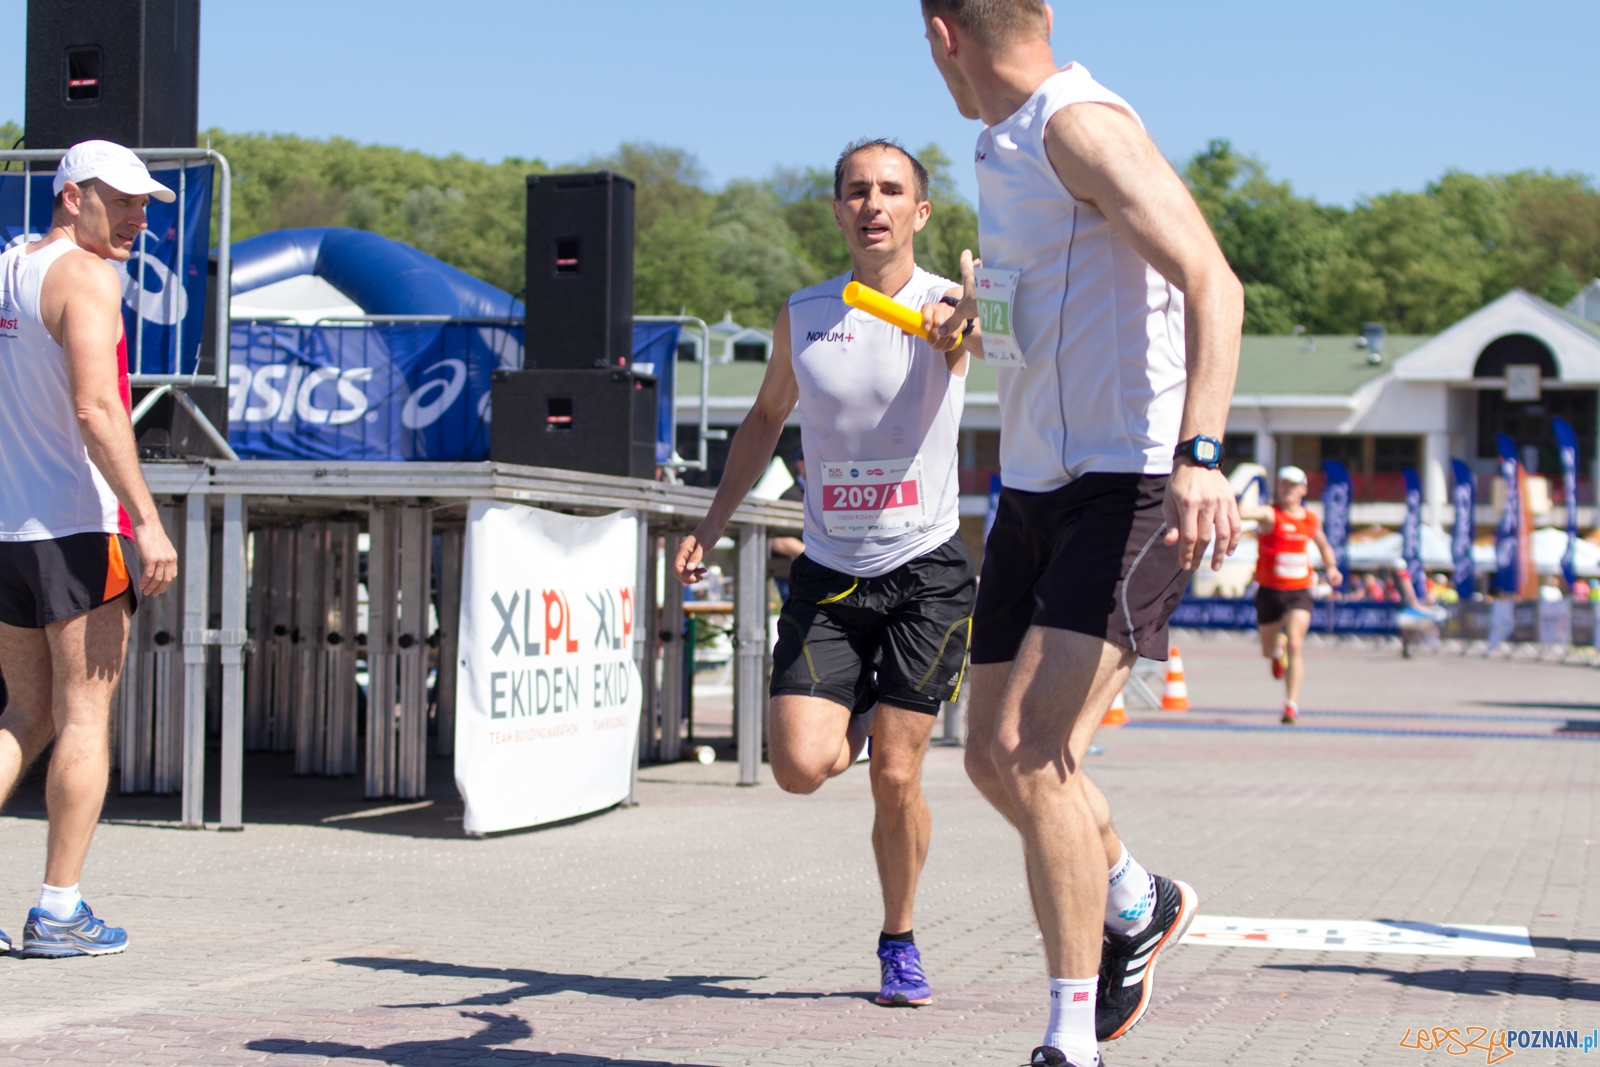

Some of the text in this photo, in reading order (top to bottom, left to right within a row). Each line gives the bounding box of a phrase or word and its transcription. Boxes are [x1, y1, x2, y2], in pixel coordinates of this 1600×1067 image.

[977, 301, 1004, 332] 9/2
[833, 483, 904, 508] 209/1
[490, 587, 579, 658] XLPL
[490, 665, 579, 719] EKIDEN
[593, 660, 632, 708] EKID
[490, 731, 512, 745] TEAM
[515, 726, 546, 743] BUILDING
